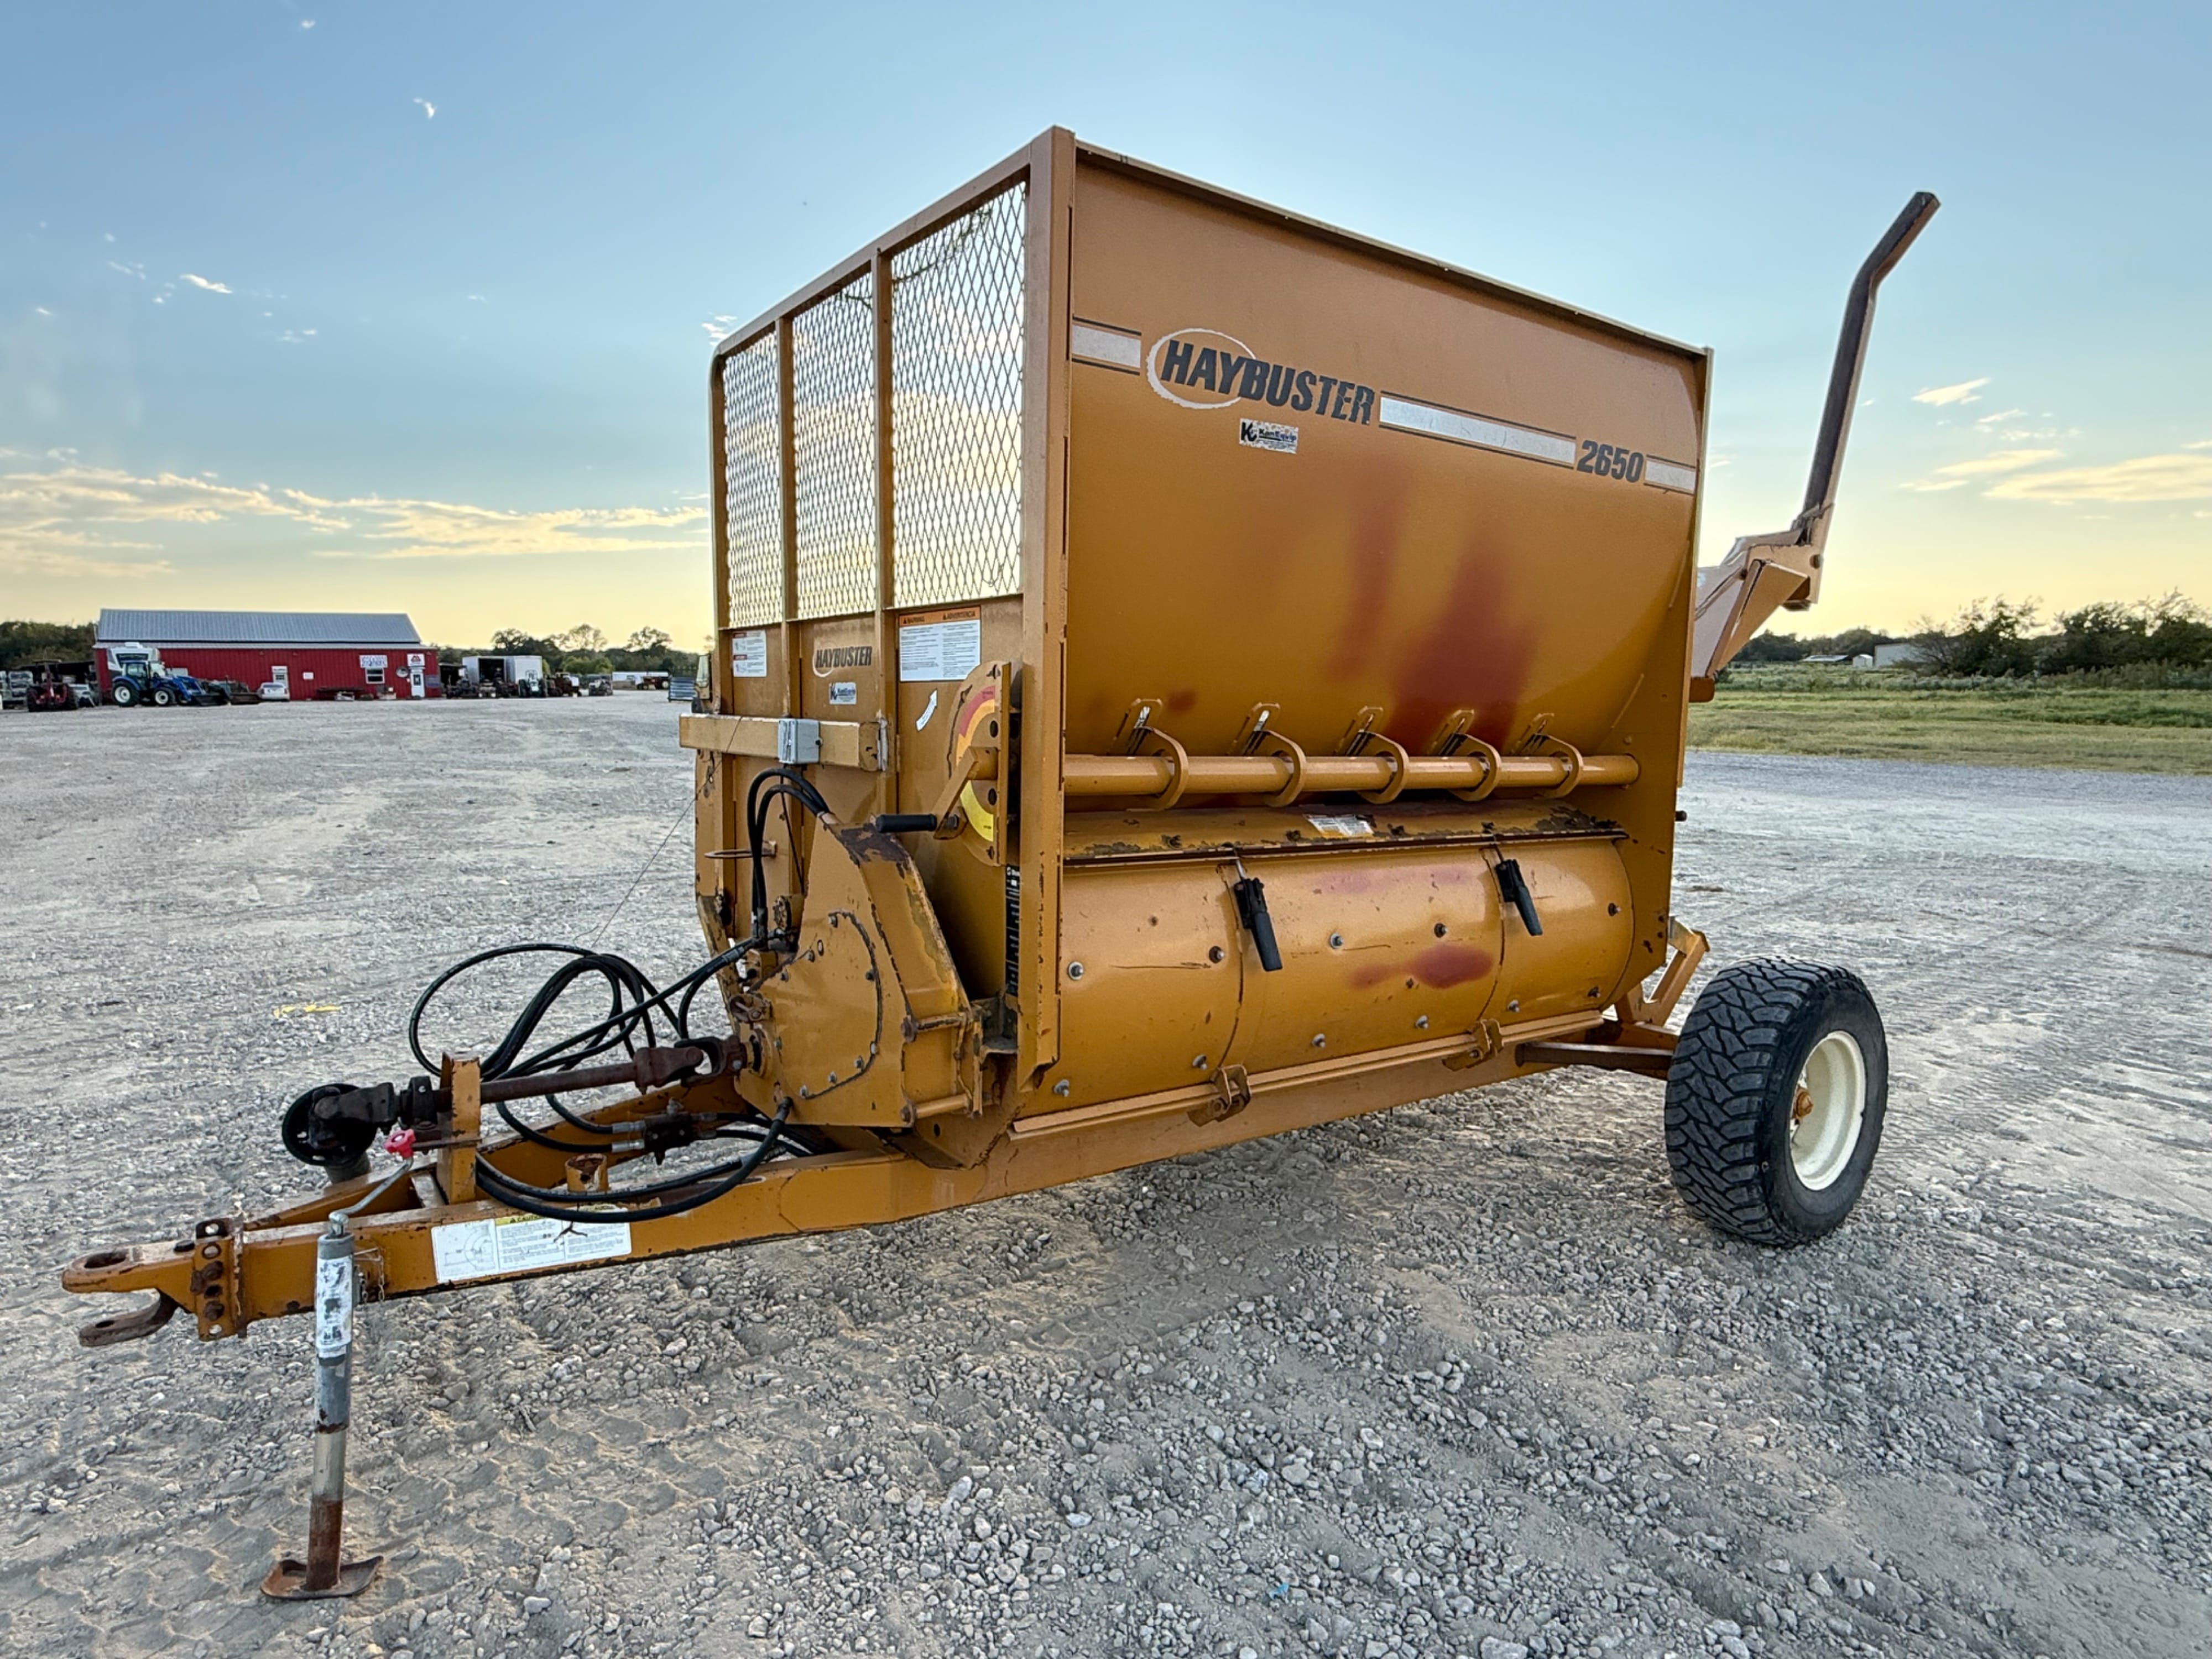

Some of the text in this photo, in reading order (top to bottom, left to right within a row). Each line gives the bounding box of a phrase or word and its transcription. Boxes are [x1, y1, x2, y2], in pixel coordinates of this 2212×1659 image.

[1161, 340, 1375, 425] HAYBUSTER
[1577, 440, 1644, 483] 2650
[815, 646, 872, 668] HAYBUSTER
